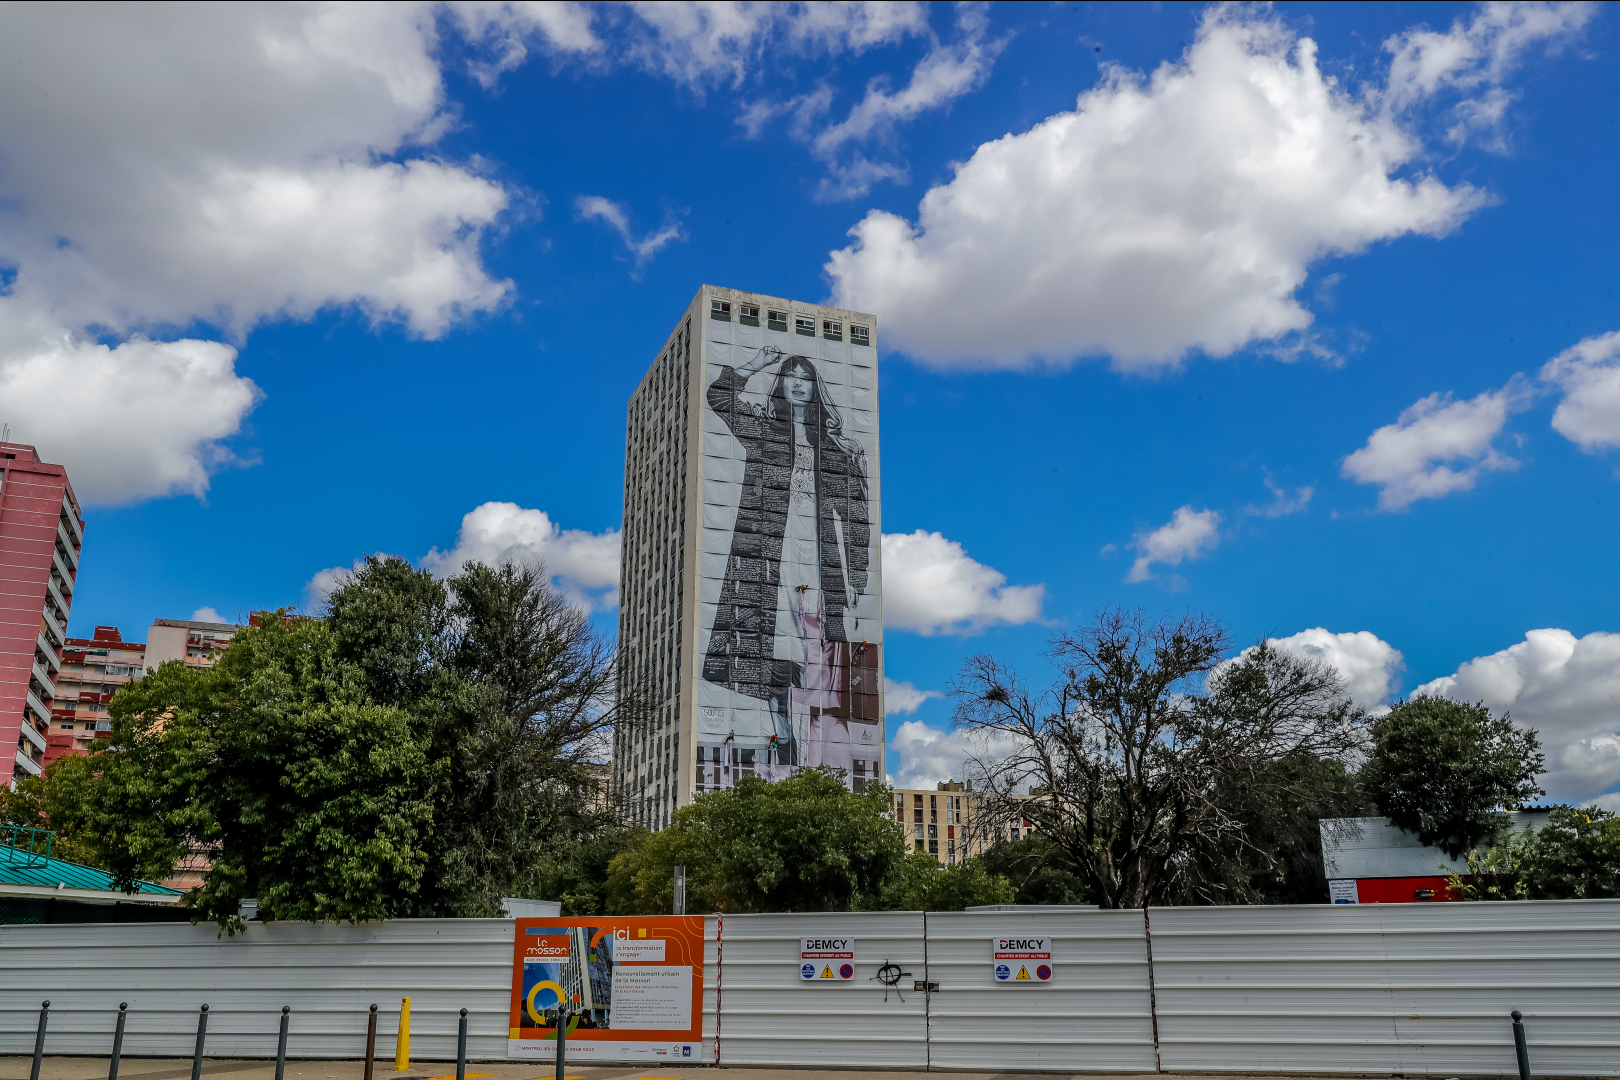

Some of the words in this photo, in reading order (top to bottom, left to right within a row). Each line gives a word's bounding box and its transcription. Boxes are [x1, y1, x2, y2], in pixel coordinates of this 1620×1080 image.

[613, 926, 630, 941] ici
[806, 939, 848, 950] DEMCY
[1000, 939, 1044, 950] DEMCY
[526, 947, 567, 955] mosson
